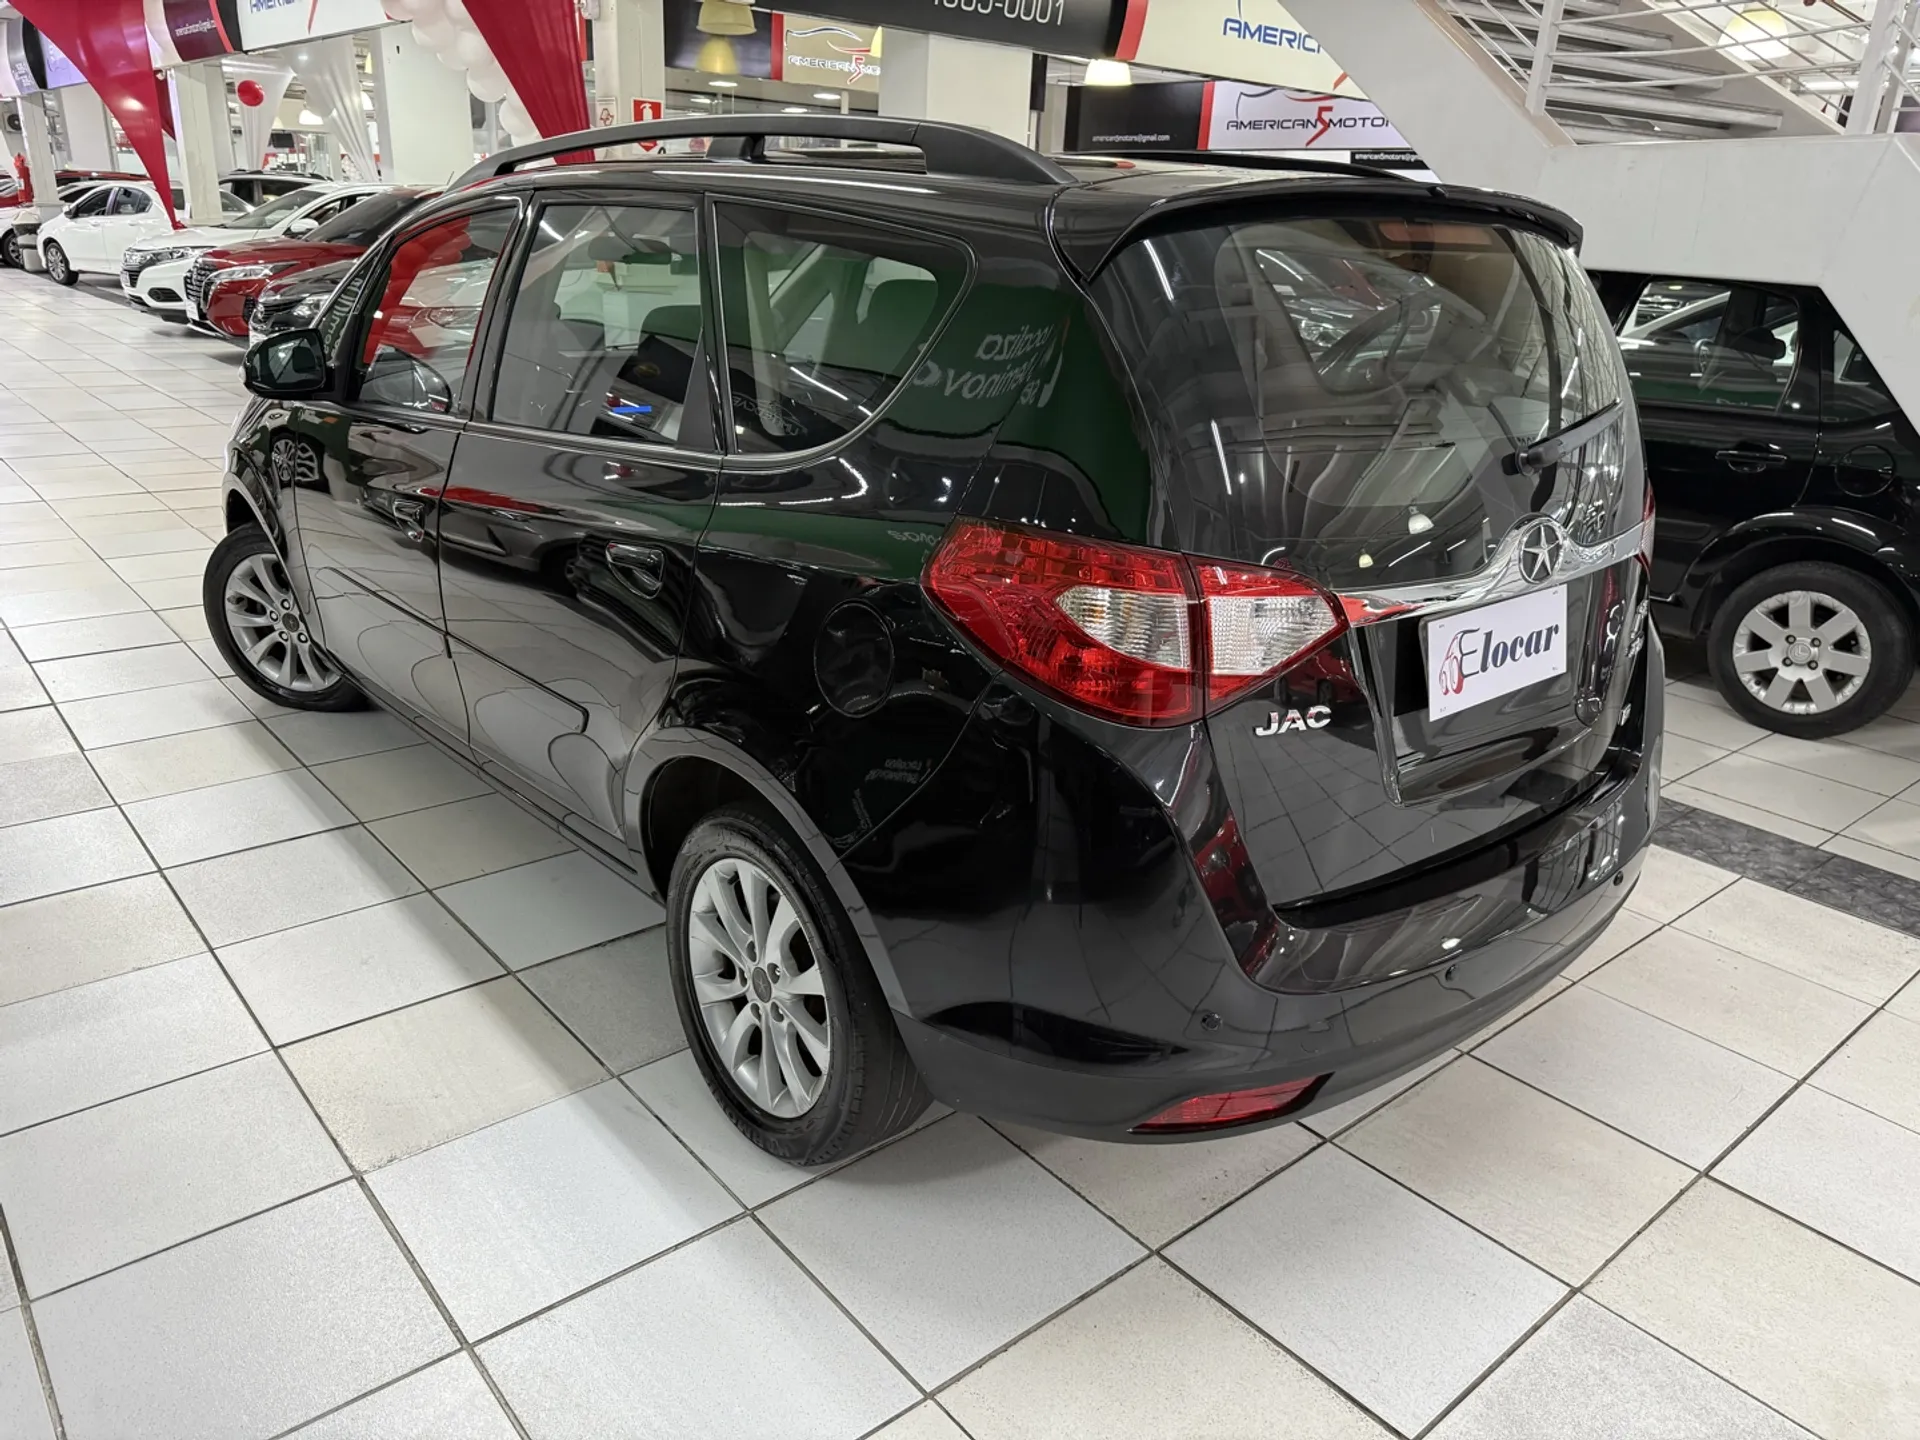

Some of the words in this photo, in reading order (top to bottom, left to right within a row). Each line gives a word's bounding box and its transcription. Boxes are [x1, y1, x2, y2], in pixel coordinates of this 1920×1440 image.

[1226, 118, 1318, 131] AMERICAN
[1327, 116, 1389, 129] MOTO
[1458, 623, 1560, 679] Elocar
[1254, 705, 1332, 737] JAC
